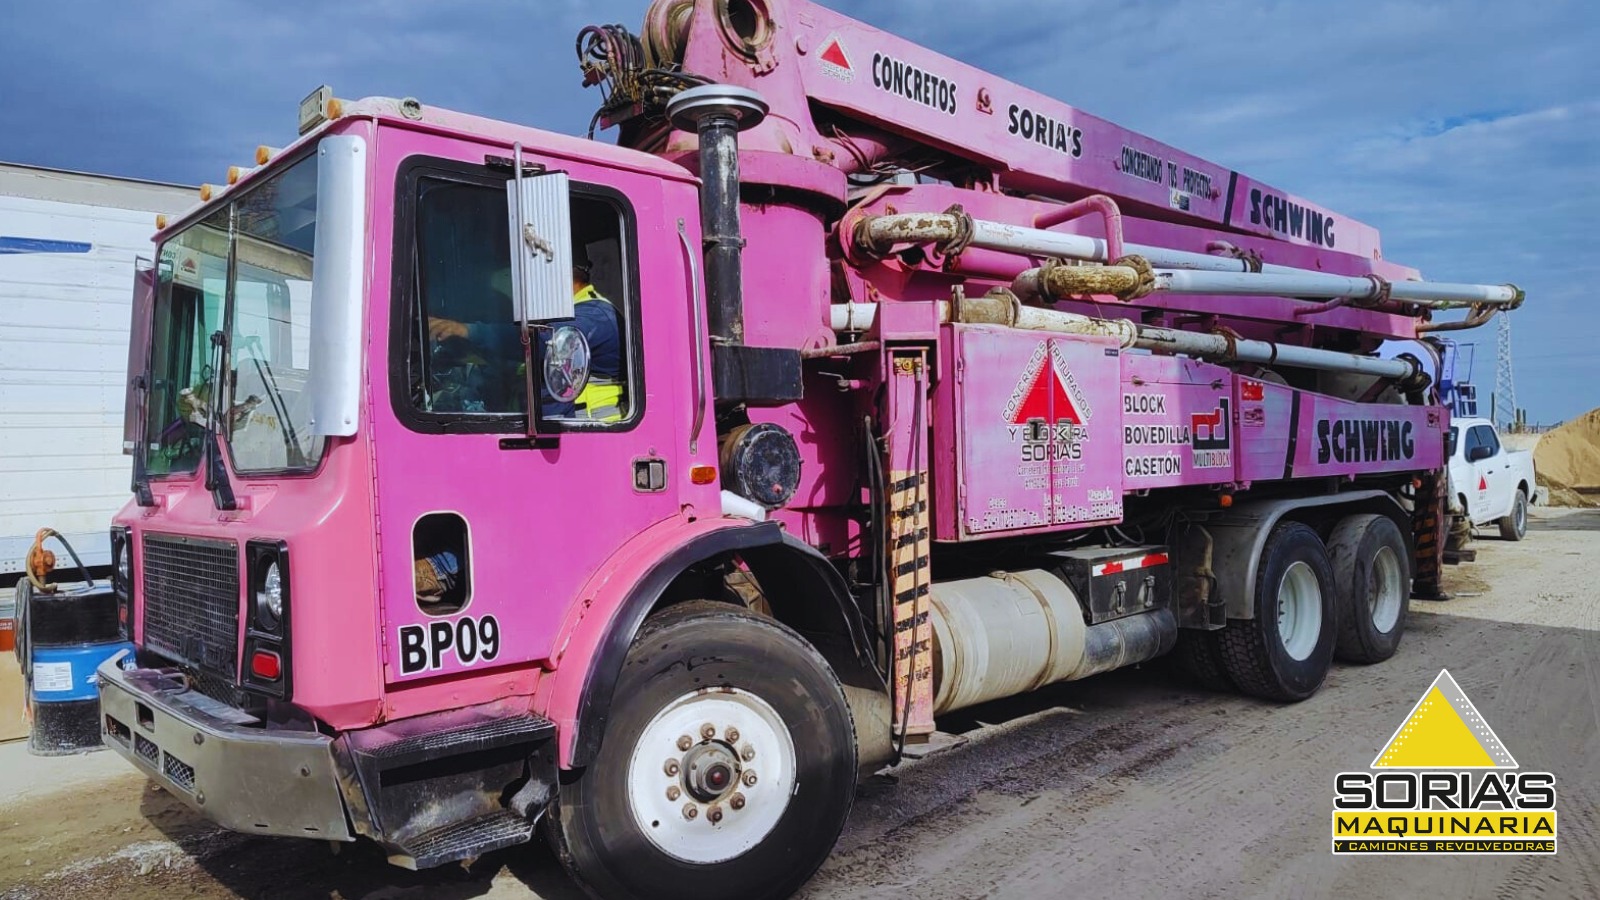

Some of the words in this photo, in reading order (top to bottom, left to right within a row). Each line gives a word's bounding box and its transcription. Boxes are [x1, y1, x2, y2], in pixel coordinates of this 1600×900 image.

[872, 52, 957, 115] CONCRETOS
[1008, 104, 1083, 158] SORIA'S
[1121, 146, 1162, 184] CONCRETANDO
[1167, 161, 1178, 189] TUS
[1183, 167, 1212, 200] PROYECTOS
[1250, 188, 1335, 248] SCHWING
[1002, 341, 1047, 421] CONCRETOS
[1050, 340, 1092, 419] TRITURADOS
[1124, 395, 1166, 413] BLOCK
[1008, 427, 1018, 441] Y
[1021, 442, 1082, 462] SORIA'S
[1124, 426, 1191, 444] BOVEDILLA
[1317, 419, 1415, 464] SCHWING
[1125, 451, 1181, 476] CASETÓN
[1194, 451, 1230, 467] MULTIBLOCK
[399, 614, 500, 675] BP09
